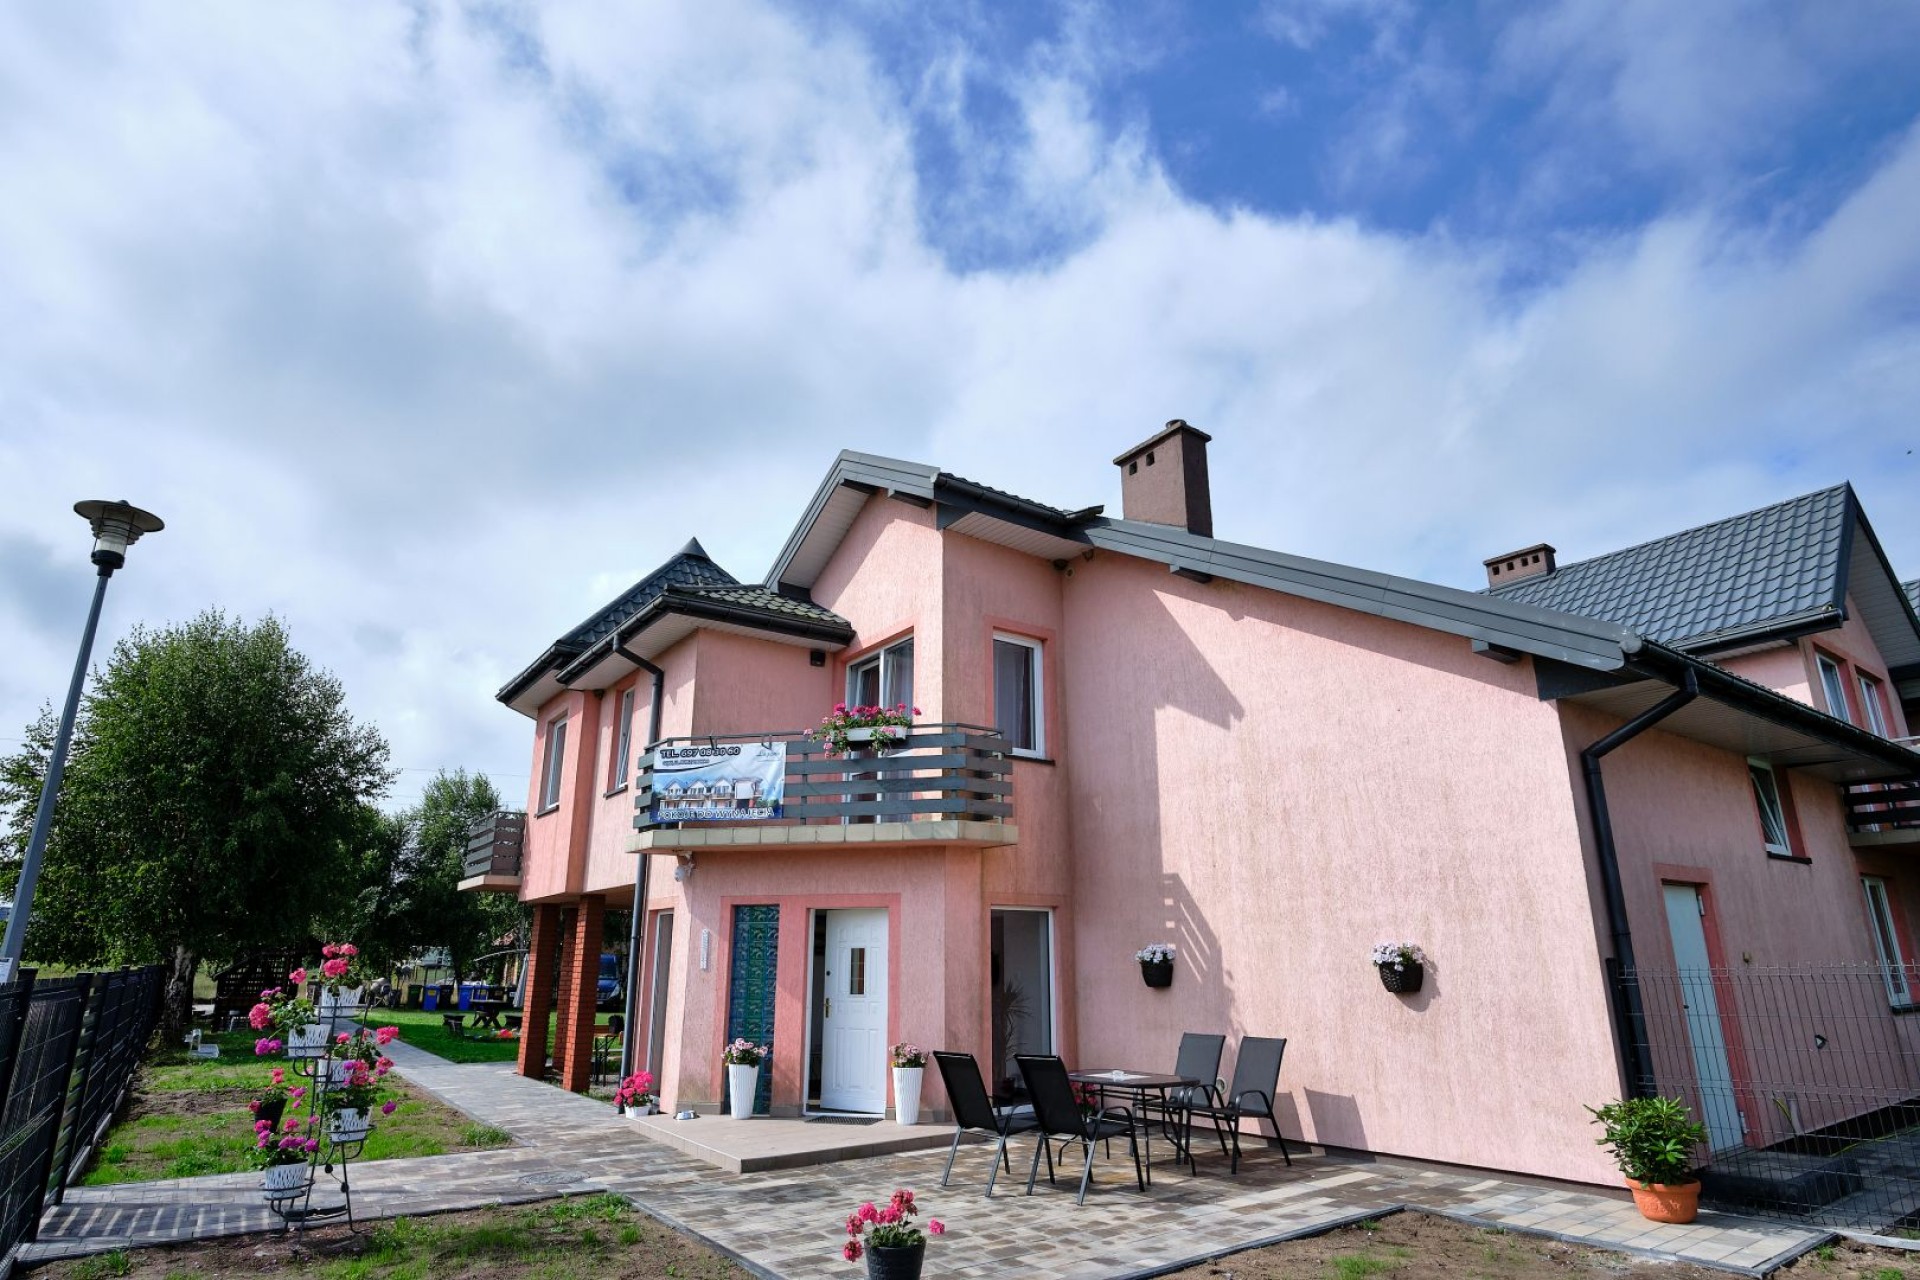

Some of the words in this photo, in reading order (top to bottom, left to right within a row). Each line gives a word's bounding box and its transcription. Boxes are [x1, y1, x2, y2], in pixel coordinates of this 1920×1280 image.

[660, 749, 679, 759] TEL.
[680, 748, 699, 758] 697
[658, 810, 695, 820] POKOJE
[696, 810, 713, 819] DO
